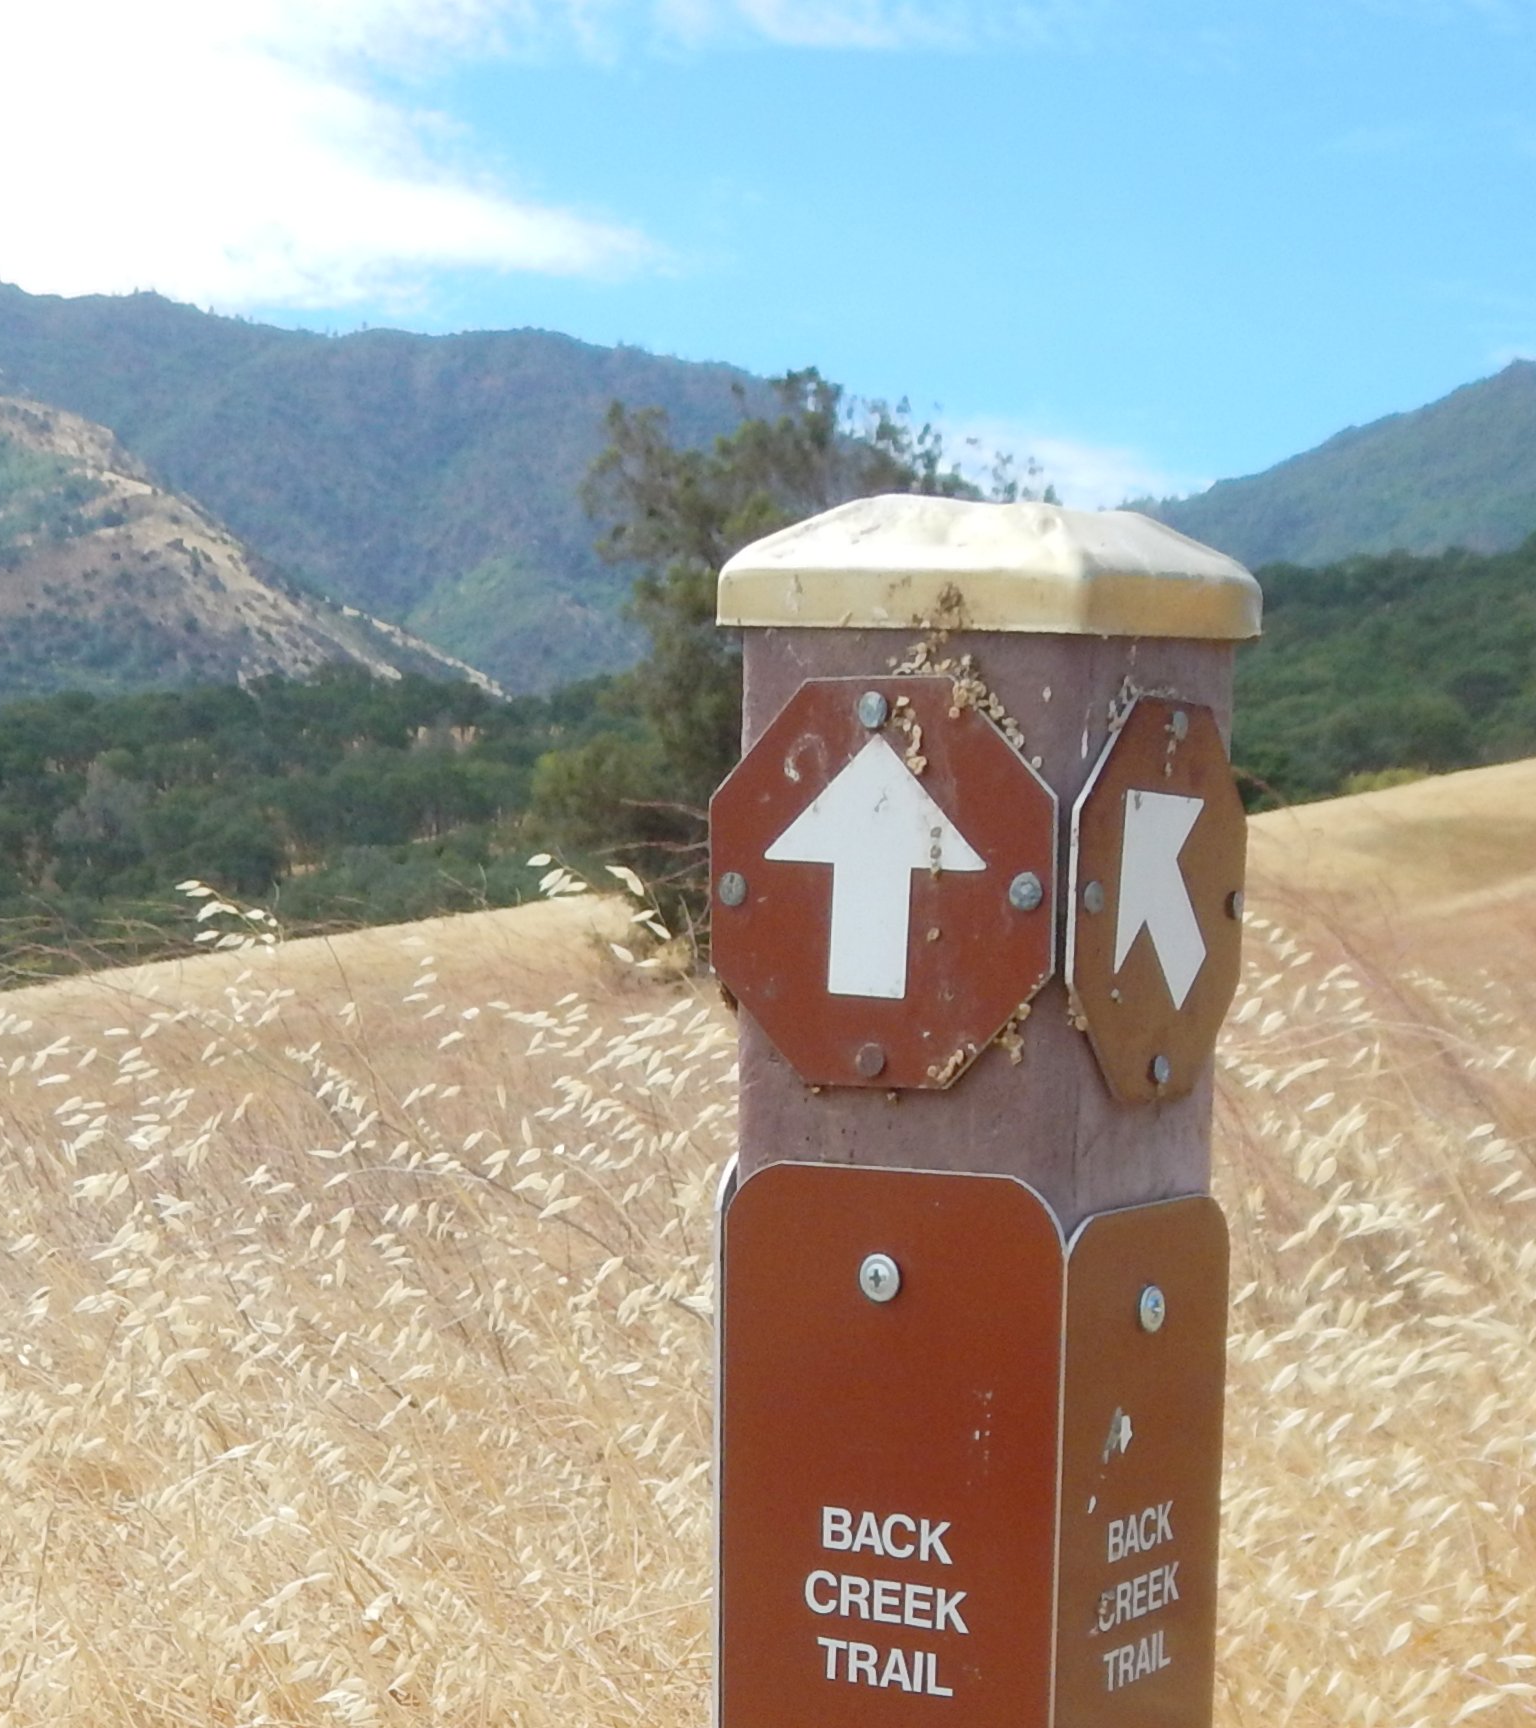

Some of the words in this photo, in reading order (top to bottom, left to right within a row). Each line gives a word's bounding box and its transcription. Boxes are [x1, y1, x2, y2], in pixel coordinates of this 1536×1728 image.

[821, 1506, 953, 1565] BACK
[1107, 1500, 1174, 1563] BACK
[804, 1570, 969, 1634] CREEK
[817, 1636, 953, 1697] TRAIL
[1104, 1630, 1171, 1692] TRAIL
